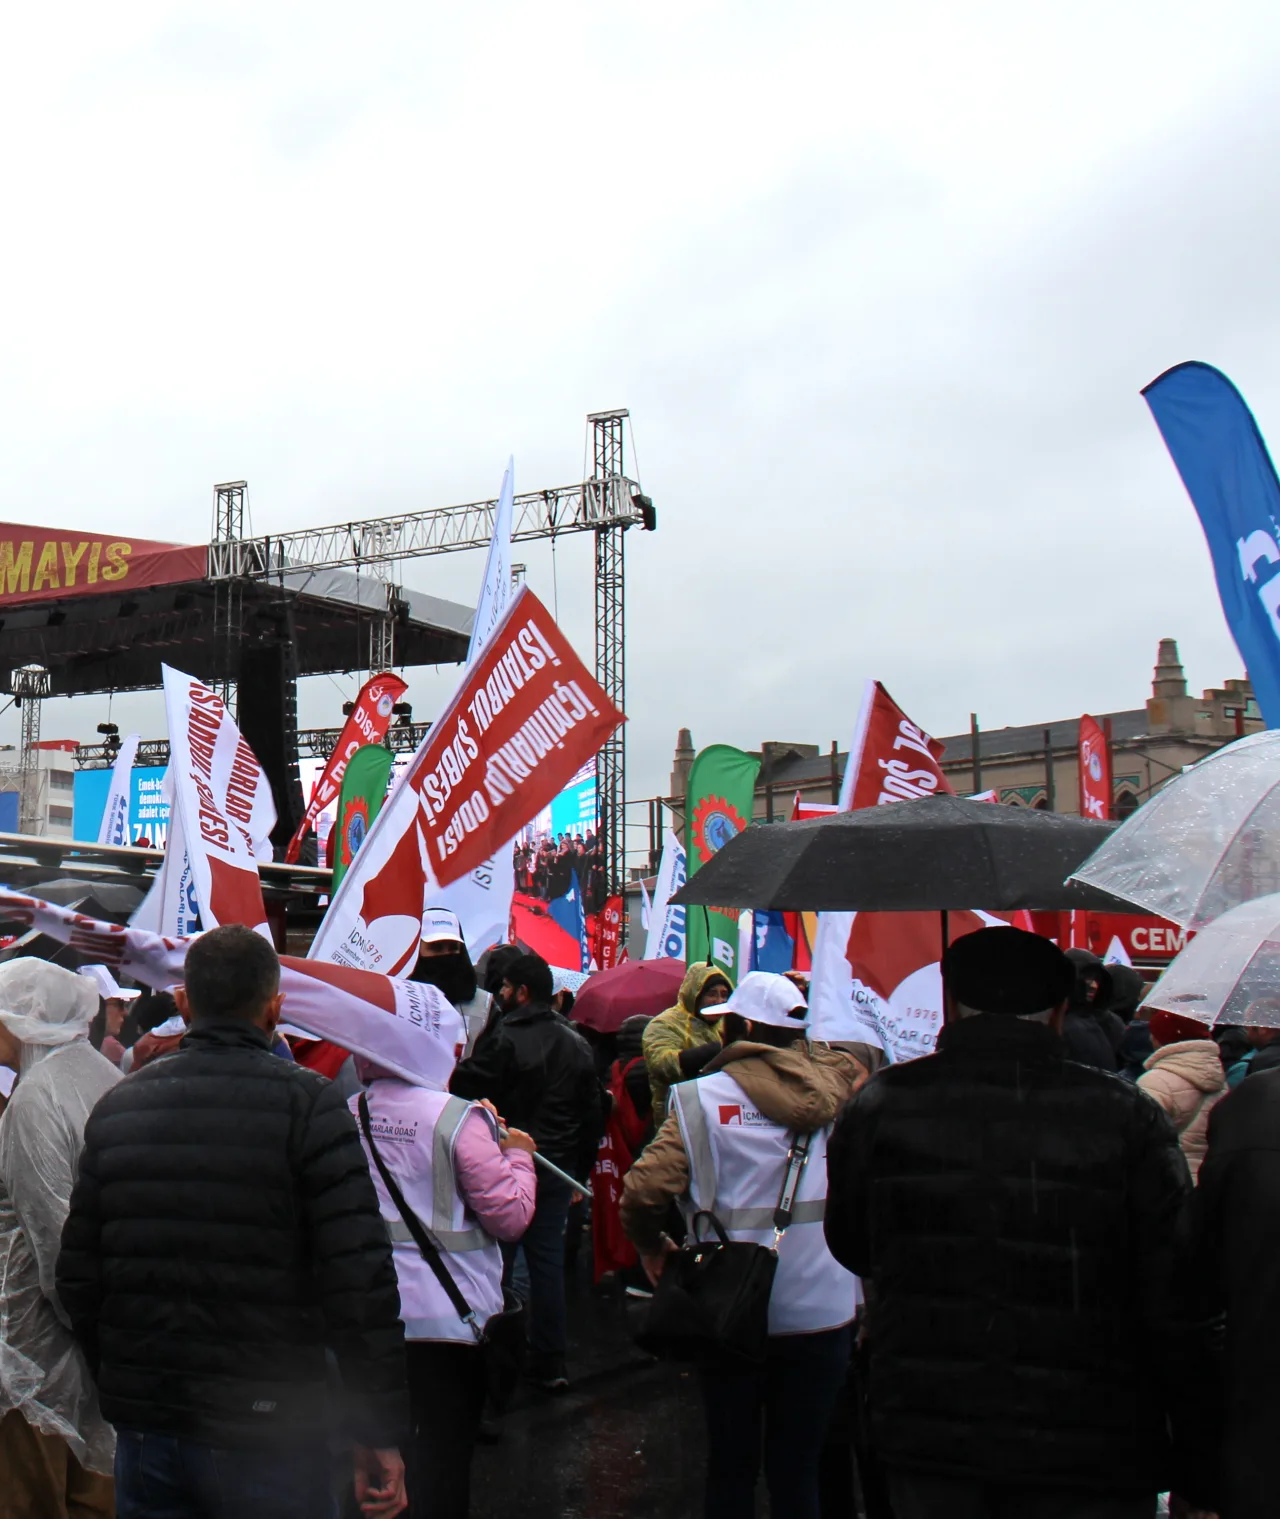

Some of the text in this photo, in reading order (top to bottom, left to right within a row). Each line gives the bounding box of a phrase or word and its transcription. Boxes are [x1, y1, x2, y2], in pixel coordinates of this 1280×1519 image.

[467, 619, 562, 736] İSTANBUL
[419, 714, 479, 827] ŞUBESİ
[436, 790, 490, 861] ODASI
[906, 1007, 938, 1021] 1976
